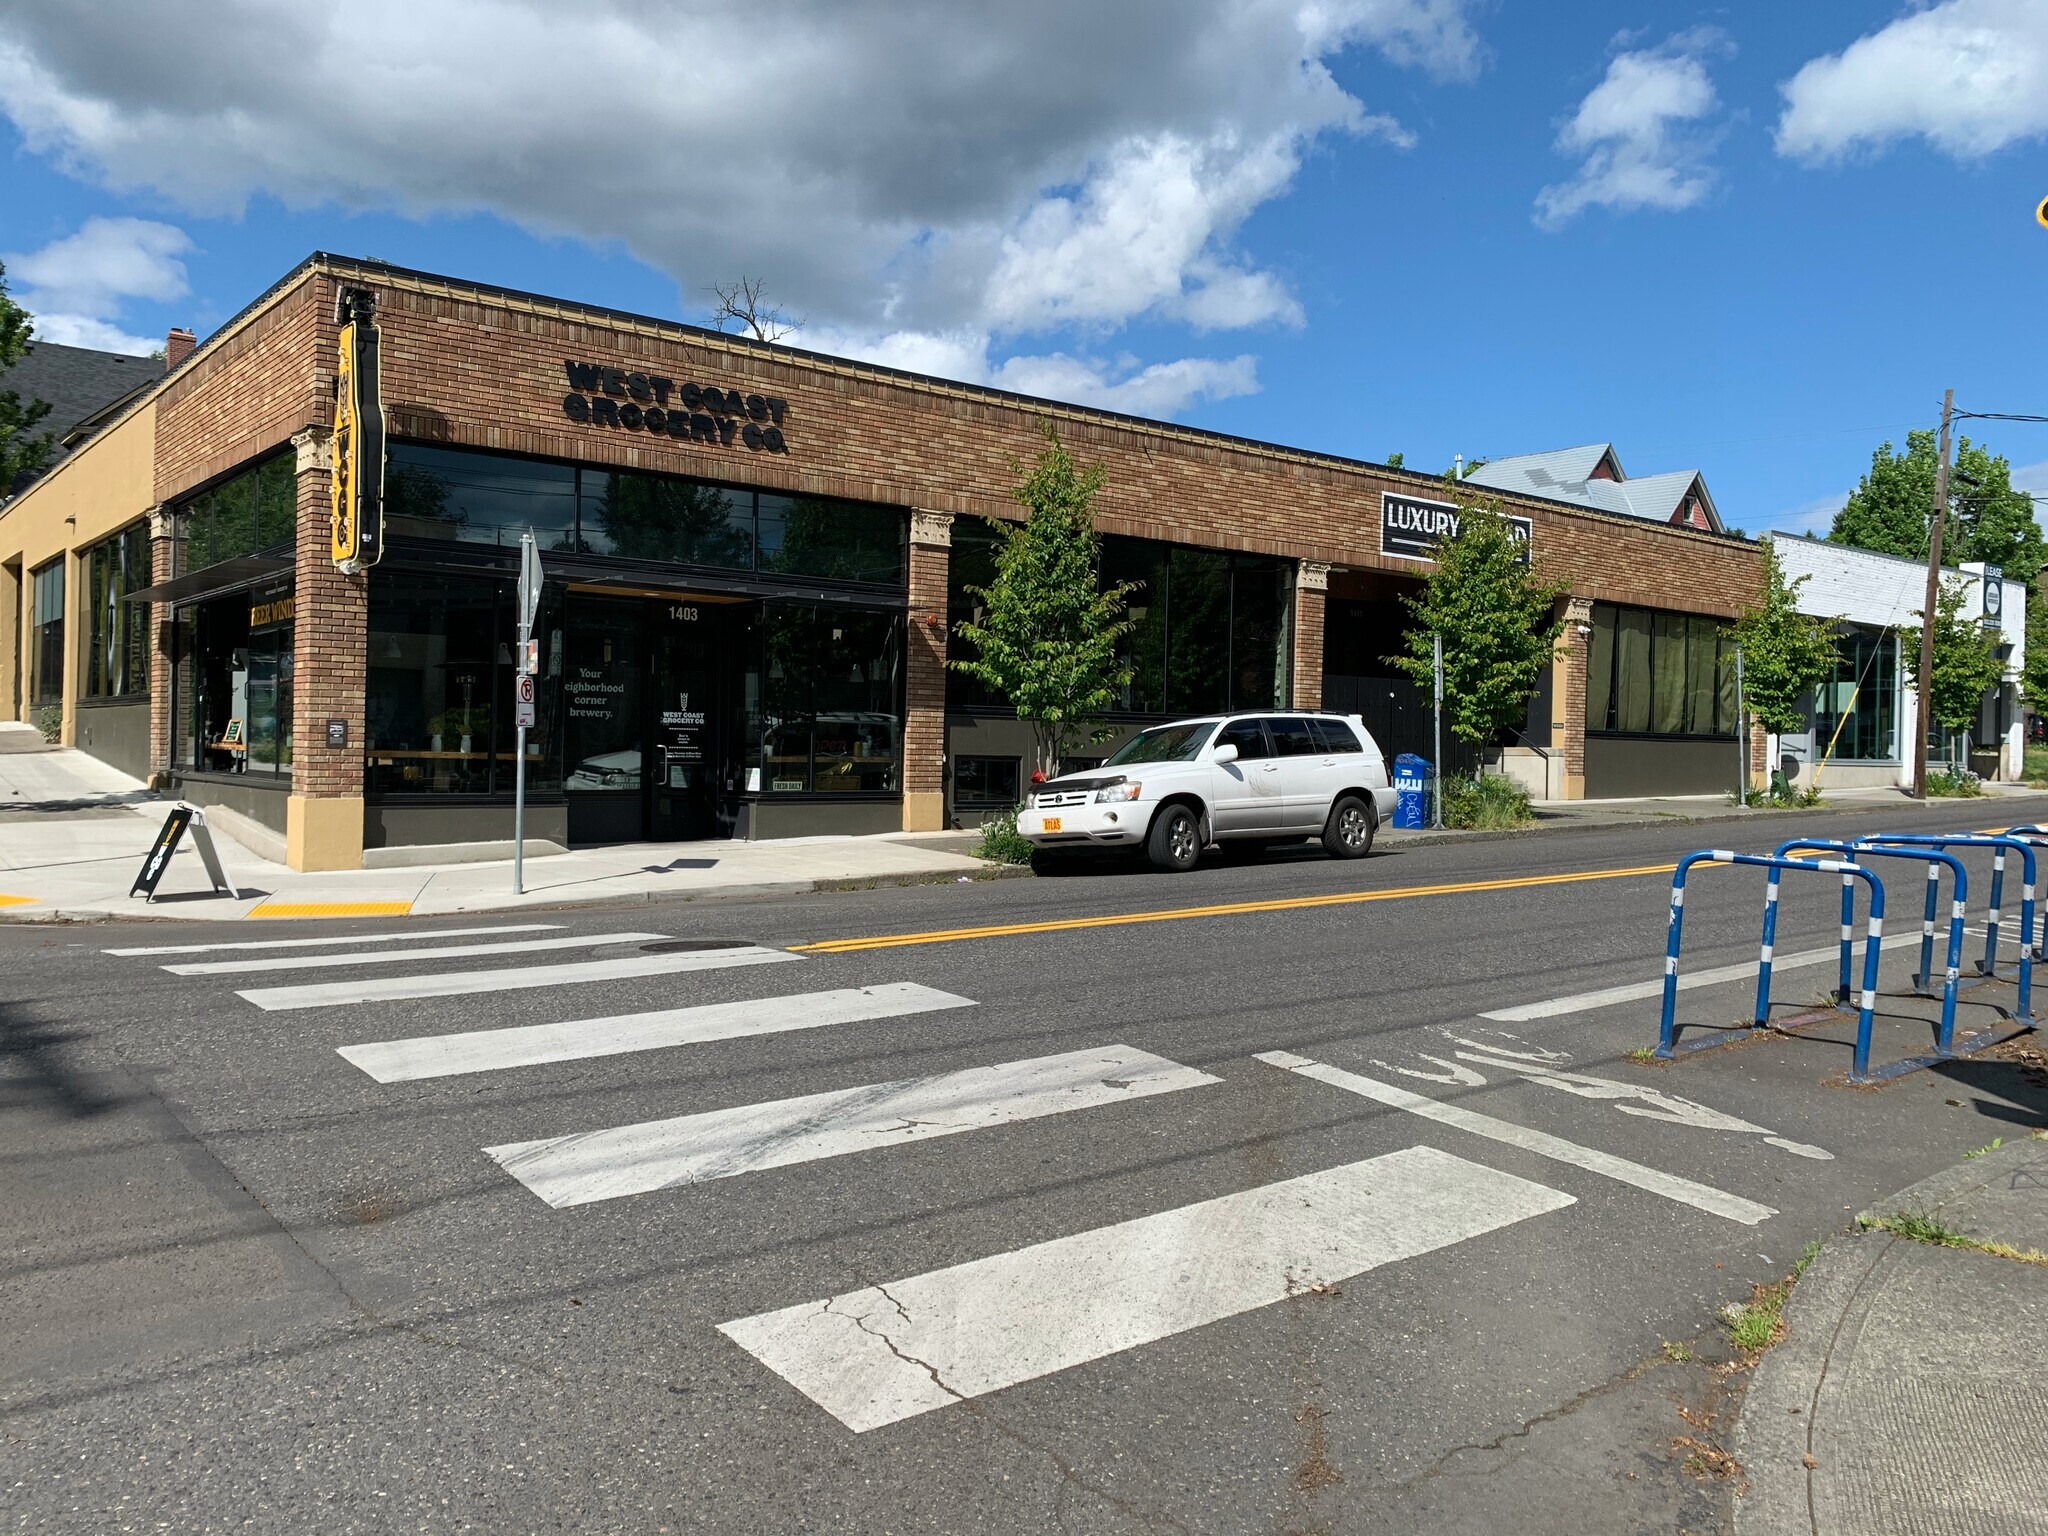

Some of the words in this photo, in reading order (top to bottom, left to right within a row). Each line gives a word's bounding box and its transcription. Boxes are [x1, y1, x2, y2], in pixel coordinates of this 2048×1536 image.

[565, 360, 673, 403] WEST
[681, 383, 788, 422] COAST
[563, 393, 735, 445] GROCERY
[742, 423, 790, 456] CO.
[1388, 503, 1459, 537] LUXURY
[251, 604, 270, 626] BEER
[271, 597, 295, 621] WIND
[669, 606, 698, 621] 1403
[579, 668, 602, 678] Your
[564, 682, 624, 693] eighborhood
[570, 707, 613, 720] brewery.
[1044, 820, 1061, 830] ATLAS
